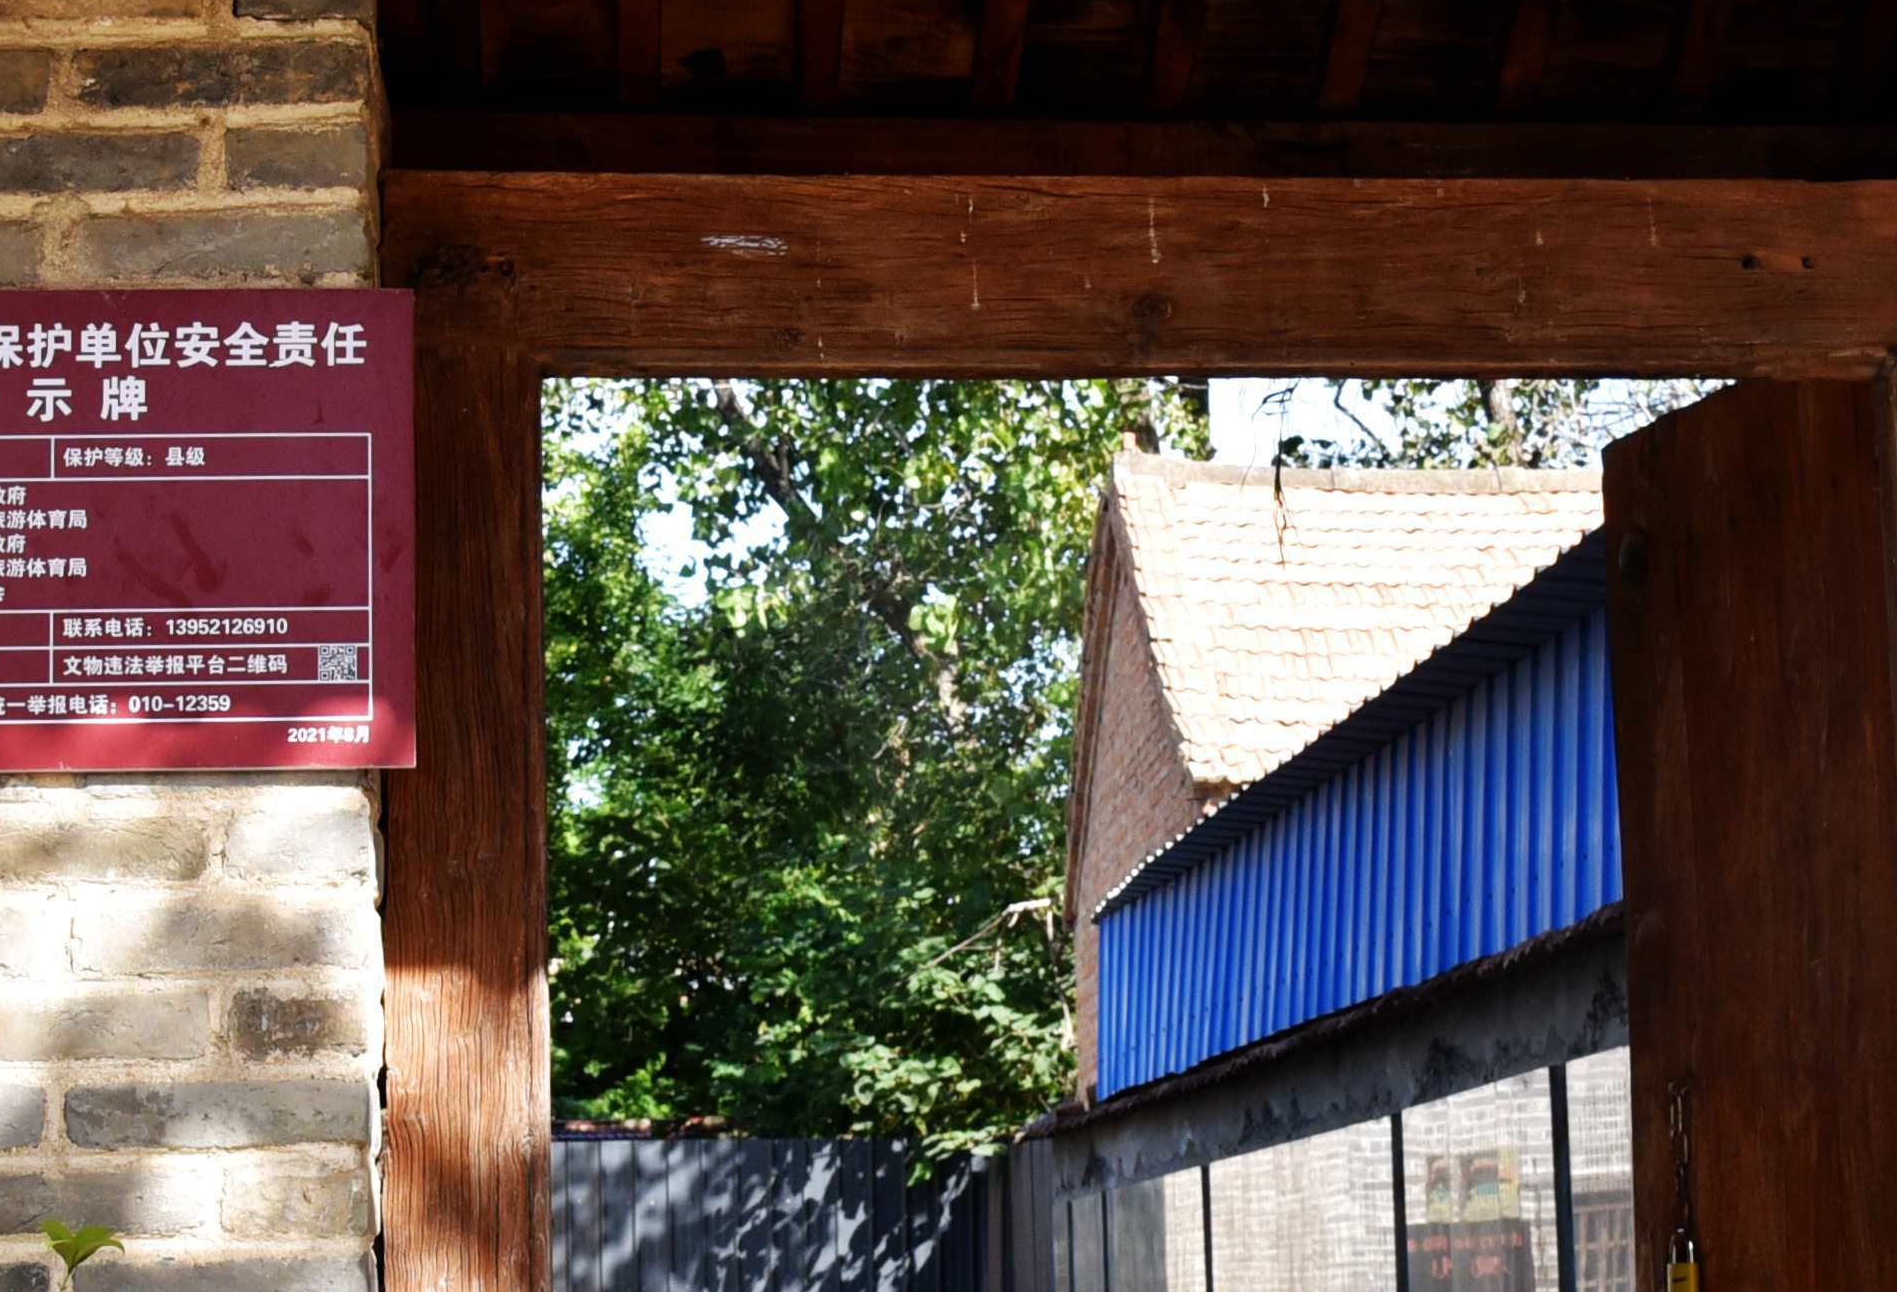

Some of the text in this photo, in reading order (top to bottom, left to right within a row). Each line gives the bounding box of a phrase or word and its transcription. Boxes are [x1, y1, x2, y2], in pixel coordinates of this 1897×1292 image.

[63, 447, 206, 467] 保护等级：县级
[63, 654, 288, 676] 文物违法举报平台二维码
